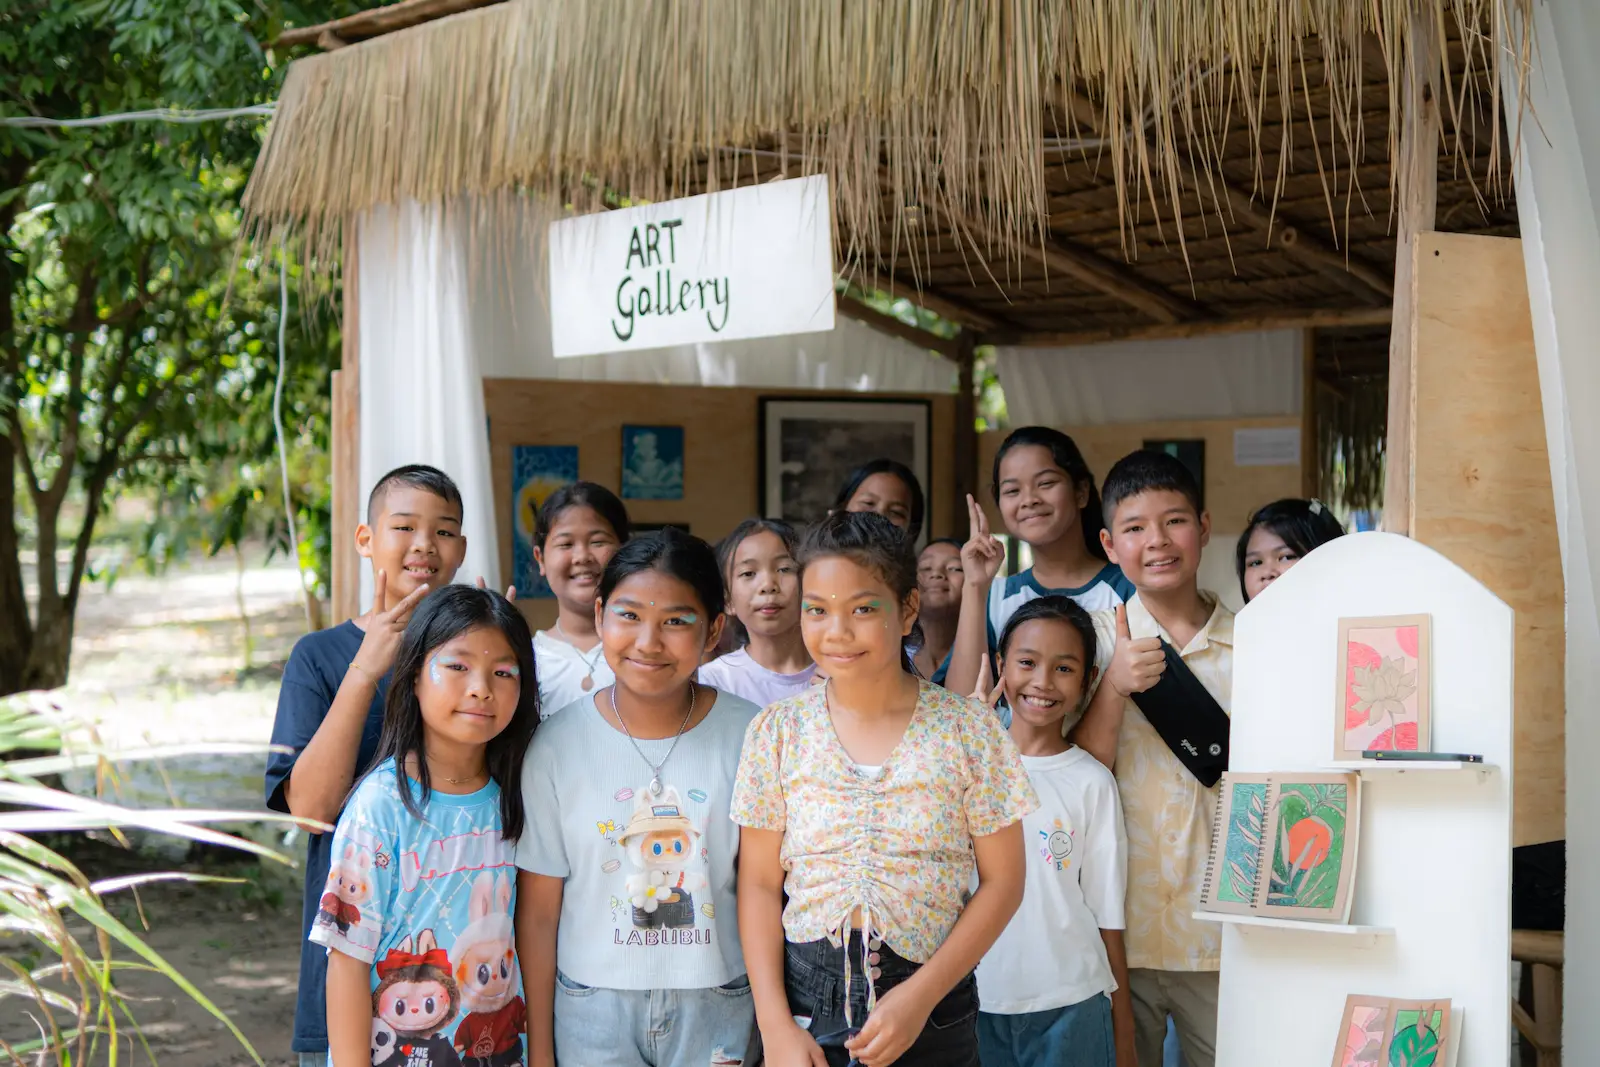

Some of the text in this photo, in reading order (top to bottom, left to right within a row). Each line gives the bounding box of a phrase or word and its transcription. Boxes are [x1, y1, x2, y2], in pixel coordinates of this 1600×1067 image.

[625, 219, 683, 270] ART
[611, 270, 729, 342] Gallery
[614, 928, 711, 946] LABUBU
